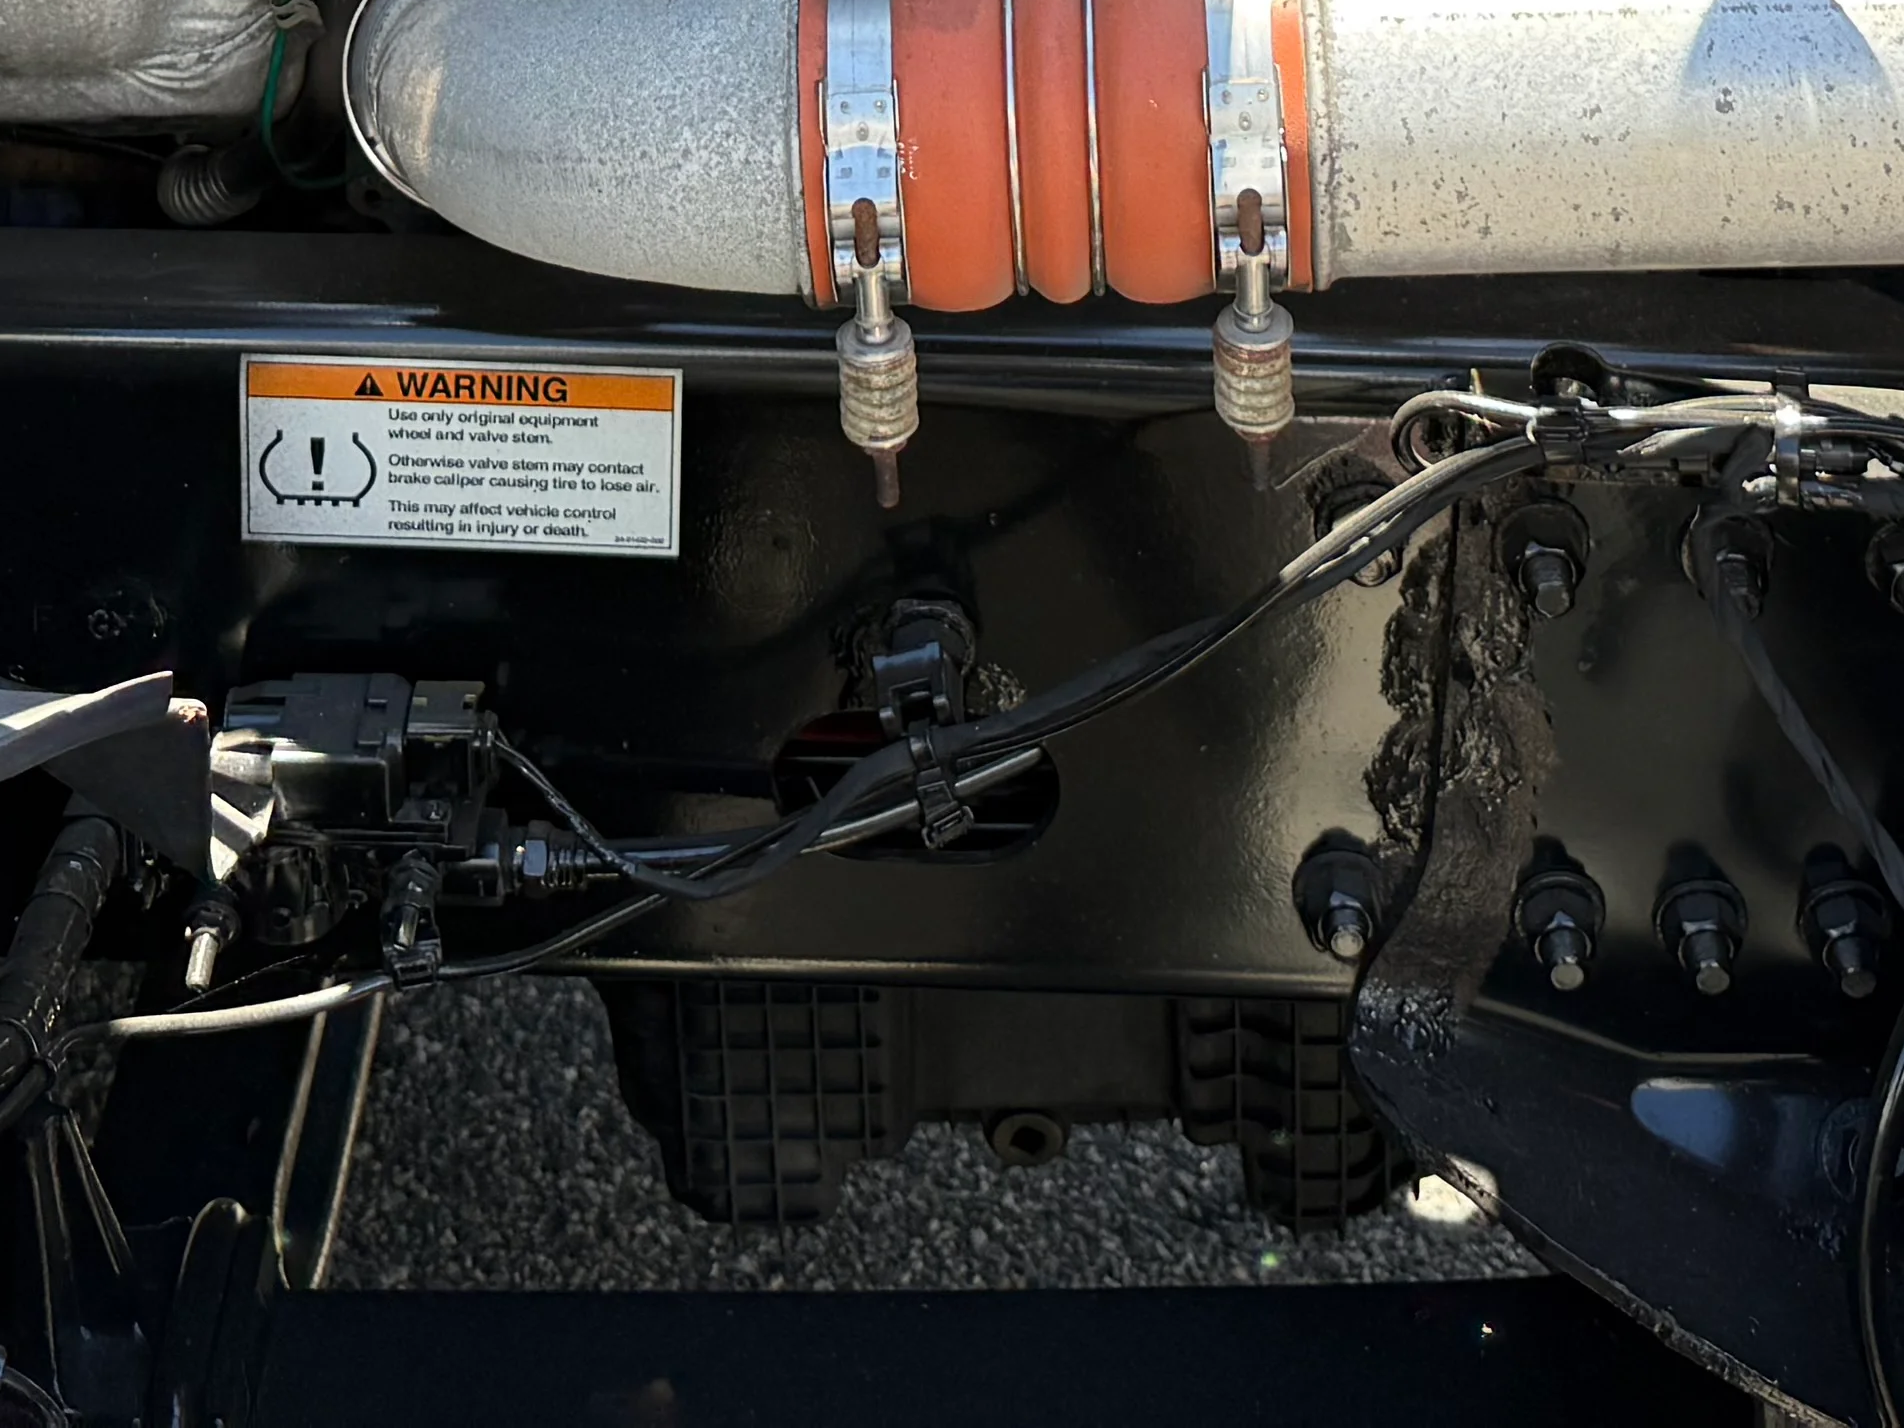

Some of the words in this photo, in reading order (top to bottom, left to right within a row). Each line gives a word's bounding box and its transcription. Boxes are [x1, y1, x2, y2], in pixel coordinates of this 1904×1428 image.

[397, 371, 568, 403] WARNING
[389, 408, 417, 422] Use
[422, 409, 454, 426] only
[458, 411, 514, 427] original
[519, 413, 598, 430] equipment
[389, 427, 431, 441] wheel
[435, 428, 464, 442] and
[469, 429, 508, 443] valve
[513, 431, 553, 445] stem.
[389, 453, 464, 469] Otherwise
[469, 456, 508, 470] valve
[512, 458, 549, 472] stem
[553, 462, 585, 476] may
[588, 461, 644, 475] contact
[389, 472, 430, 486] brake
[434, 473, 484, 490] caliper
[489, 475, 548, 492] causing
[552, 476, 577, 490] tire
[581, 478, 596, 491] to
[600, 478, 632, 492] lose
[636, 479, 659, 493] air.
[389, 499, 419, 514] This
[423, 503, 455, 518] may
[460, 501, 502, 517] affect
[507, 503, 559, 518] vehicle
[563, 505, 616, 521] control
[389, 520, 454, 537] resulting
[458, 520, 472, 533] in
[476, 521, 518, 538] injury
[523, 524, 538, 536] or
[542, 523, 589, 538] death.
